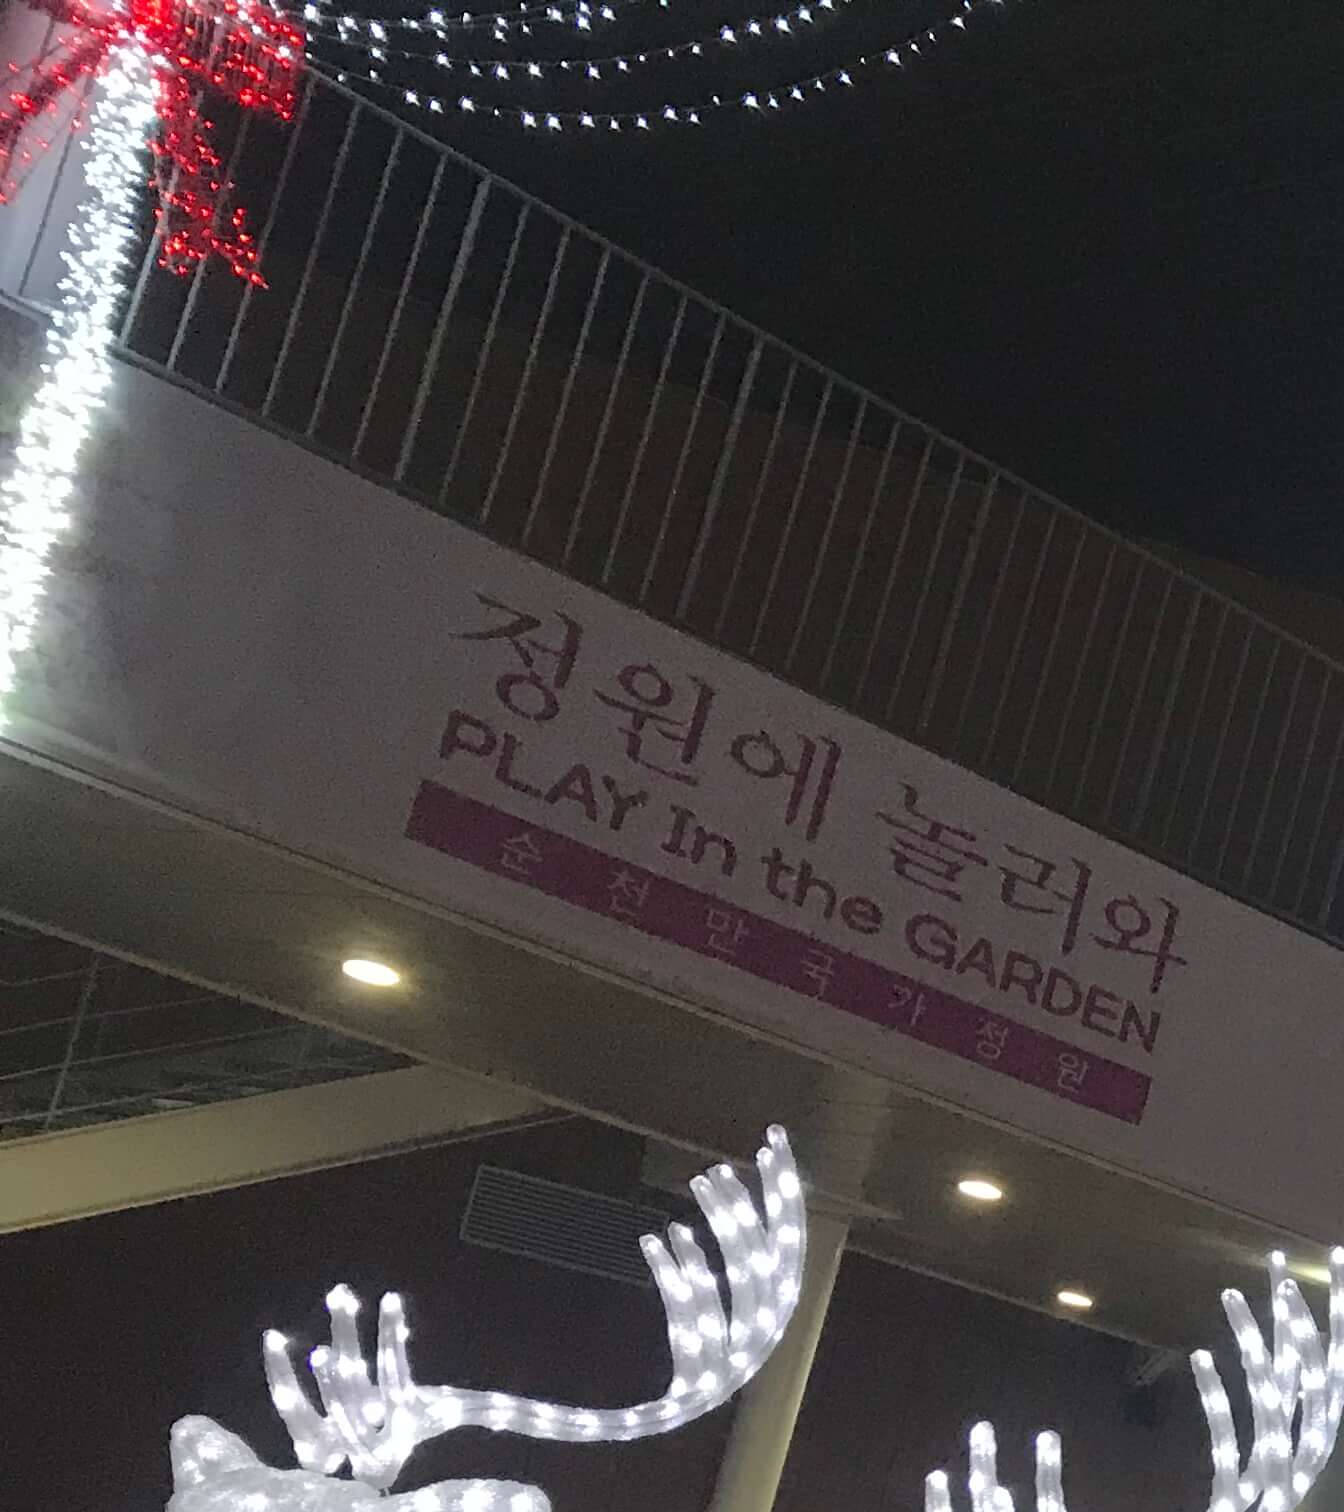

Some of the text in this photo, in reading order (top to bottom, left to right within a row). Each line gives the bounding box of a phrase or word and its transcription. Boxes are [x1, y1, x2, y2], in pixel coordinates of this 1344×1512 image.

[439, 709, 1162, 1055] PLAY In the GARDEN
[452, 591, 1188, 994] 정원에 놀러와
